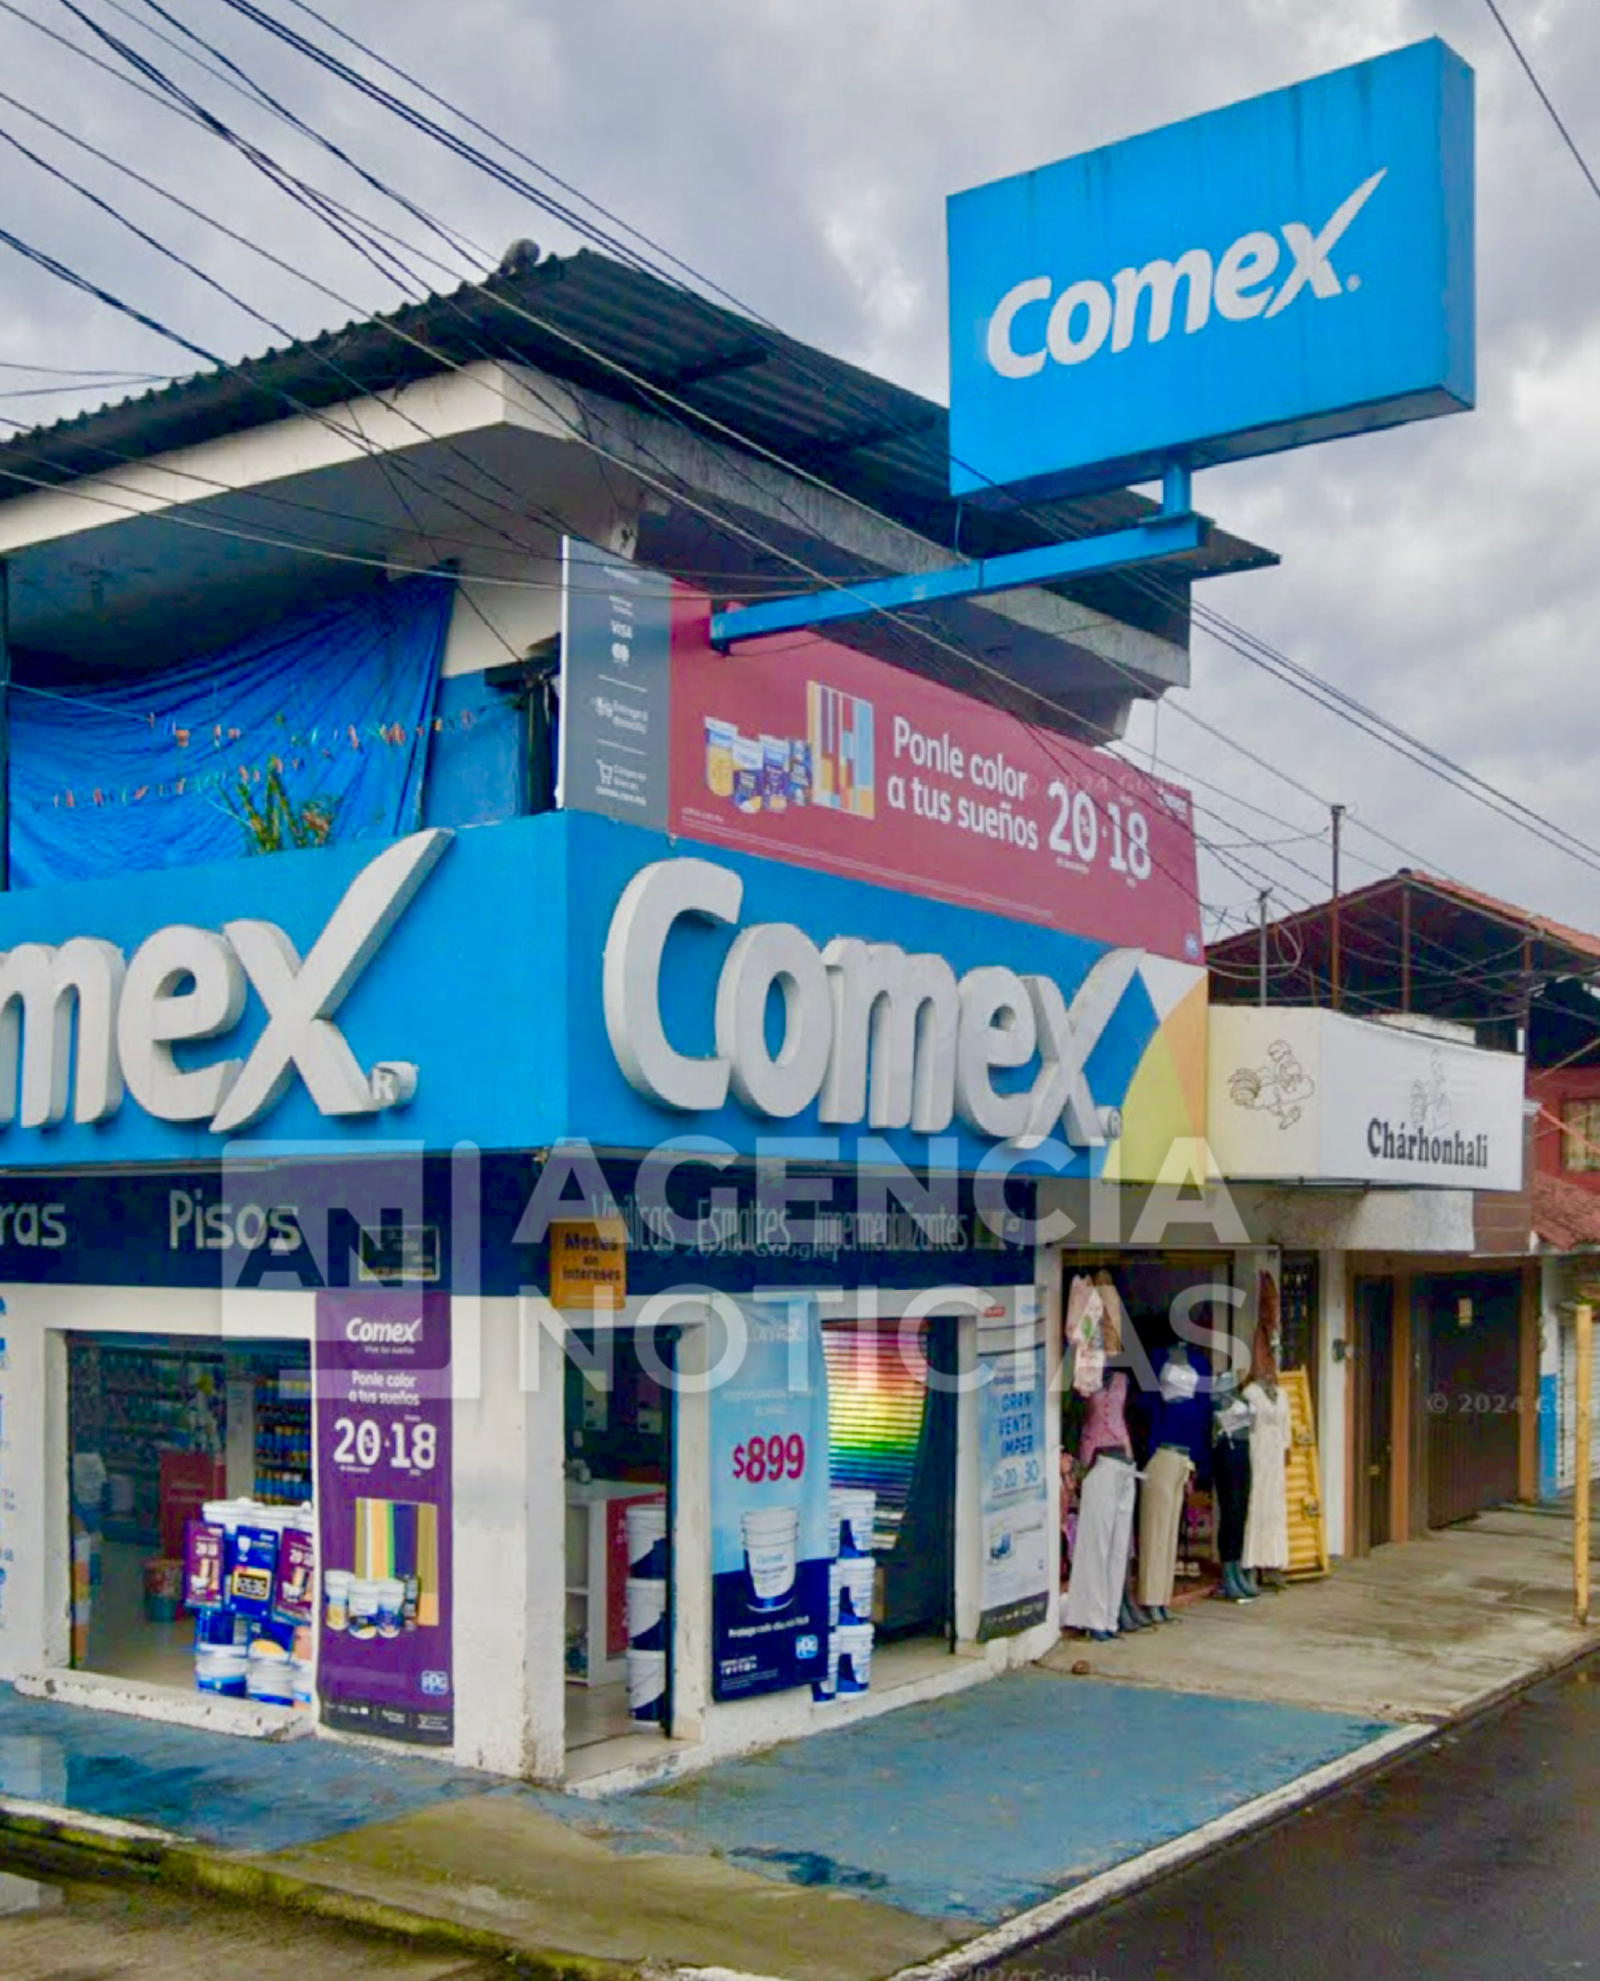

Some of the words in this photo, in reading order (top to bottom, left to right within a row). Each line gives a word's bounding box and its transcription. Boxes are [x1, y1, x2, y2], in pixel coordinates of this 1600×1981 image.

[987, 166, 1388, 379] Comex
[893, 715, 964, 779] Ponle
[970, 752, 1028, 798] color
[887, 777, 905, 808] a
[911, 776, 951, 822] tus
[957, 797, 1038, 852] sueños
[1366, 1118, 1488, 1168] Chárhonhali
[169, 1189, 302, 1250] Pisos
[565, 1233, 618, 1251] Meses
[346, 1317, 422, 1343] Comex
[348, 1391, 357, 1402] a
[359, 1390, 377, 1404] tus
[379, 1390, 420, 1406] sueños
[352, 1370, 384, 1387] Ponle
[386, 1373, 417, 1388] color
[732, 1433, 804, 1483] $899
